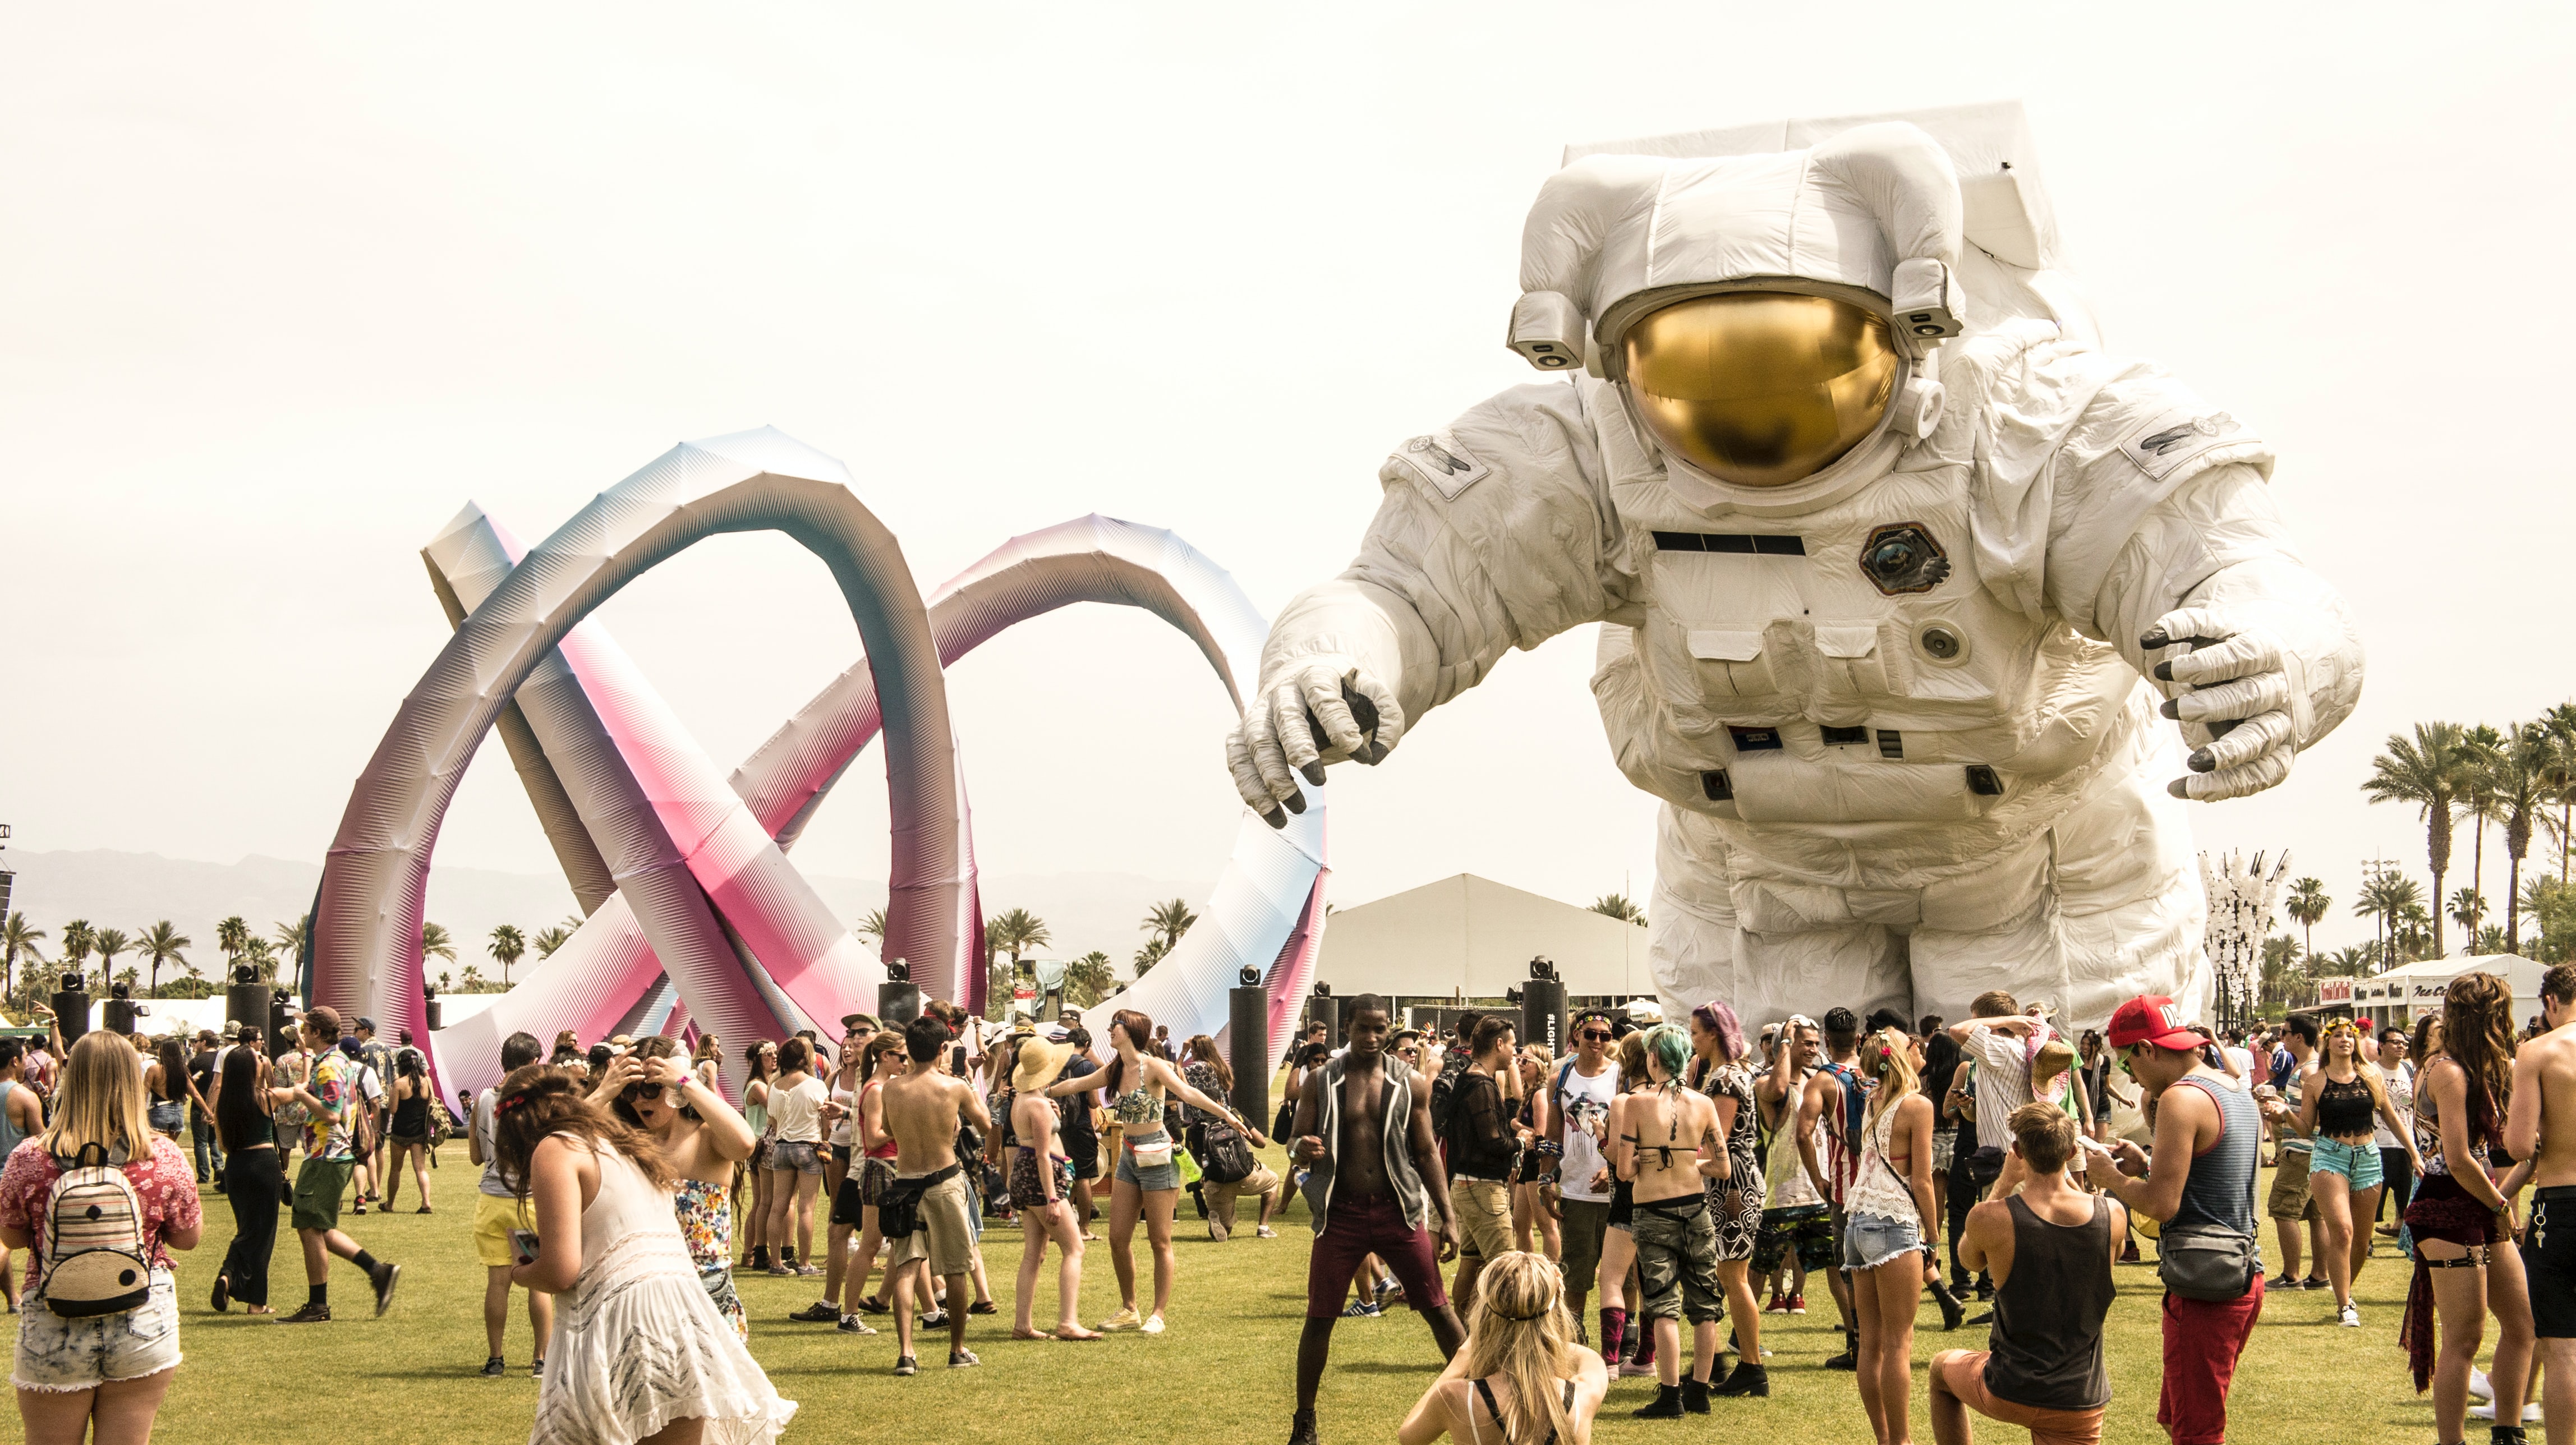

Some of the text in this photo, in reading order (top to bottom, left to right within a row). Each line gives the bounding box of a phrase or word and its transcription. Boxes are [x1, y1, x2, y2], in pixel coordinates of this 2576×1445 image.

[1921, 528, 1941, 551] VELOCITY
[1866, 569, 1885, 590] MISSION
[2413, 985, 2432, 997] Ice
